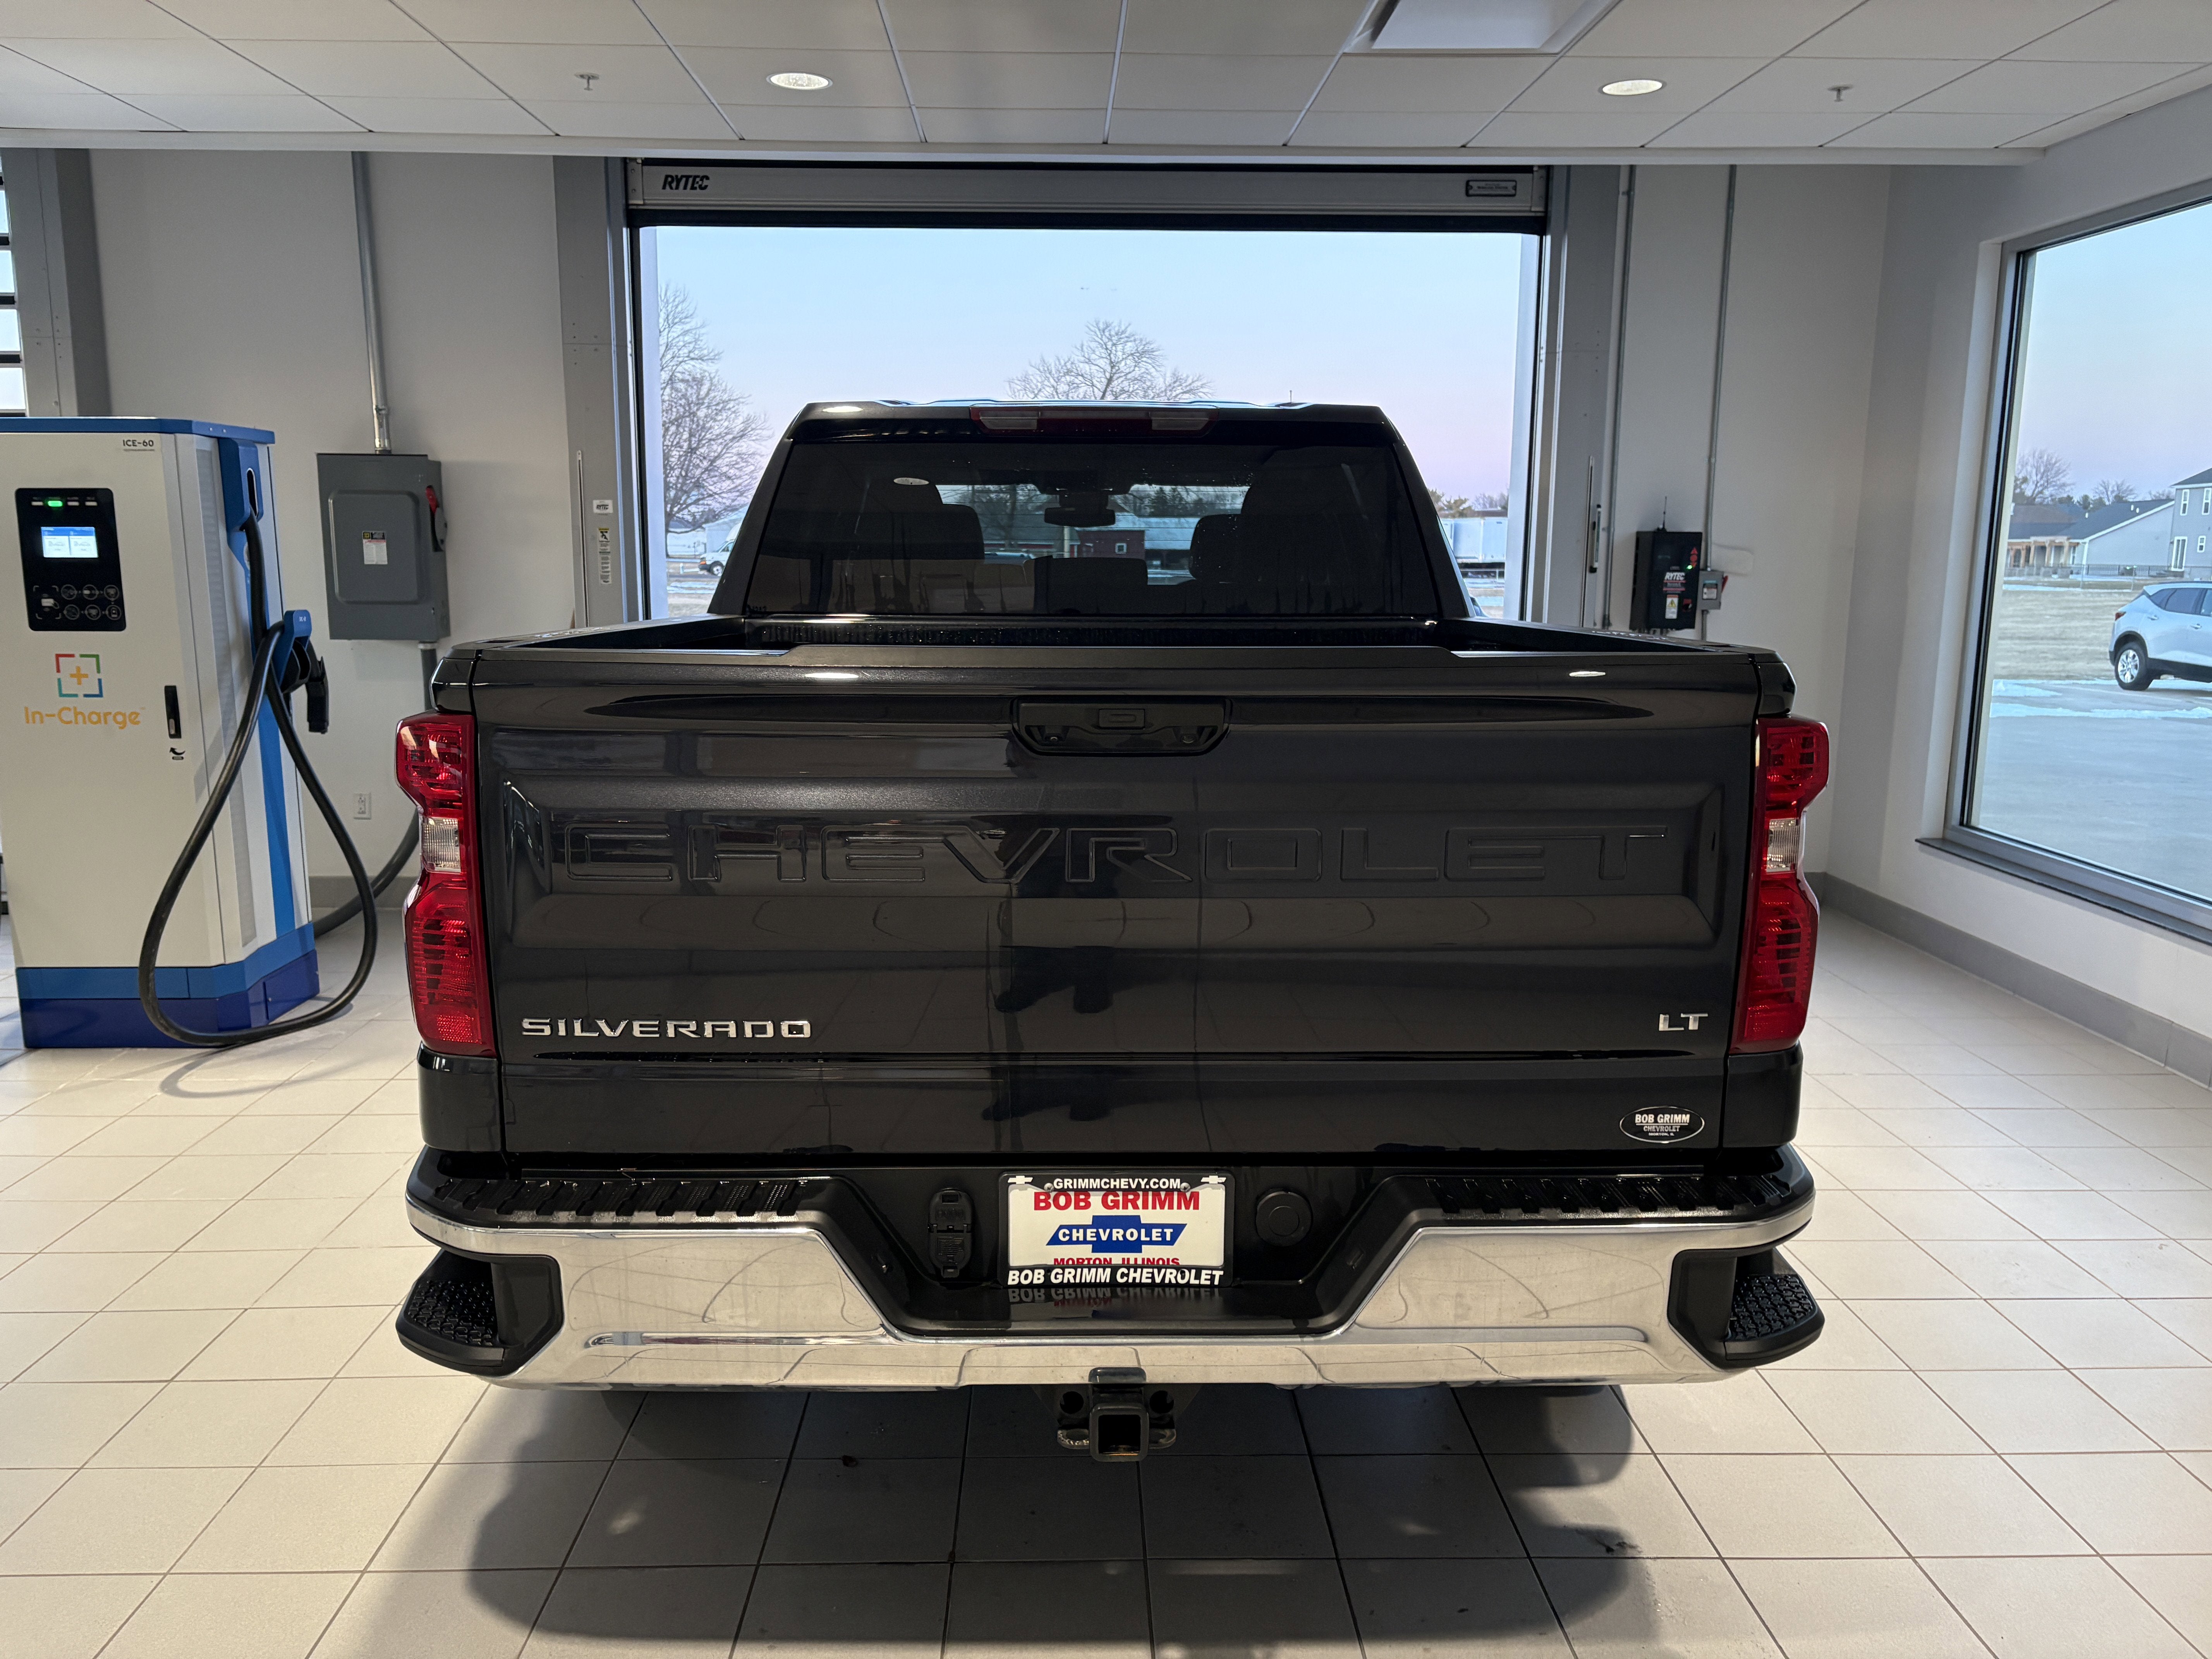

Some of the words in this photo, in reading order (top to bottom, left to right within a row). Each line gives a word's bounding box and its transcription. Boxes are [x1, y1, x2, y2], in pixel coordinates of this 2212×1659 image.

[662, 175, 709, 190] RYTEC
[1664, 572, 1686, 580] RYTEC
[566, 824, 1668, 883] CHEVROLET
[521, 1017, 812, 1038] SILVERADO
[1659, 1013, 1708, 1031] LT
[1635, 1114, 1654, 1123] BOB
[1657, 1114, 1690, 1123] GRIMM
[1053, 1178, 1181, 1189] GRIMMCHEVY.COM
[1034, 1191, 1091, 1210] BOB
[1101, 1191, 1199, 1210] GRIMM
[1058, 1228, 1173, 1242] CHEVROLET
[1008, 1270, 1044, 1285] BOB
[1050, 1268, 1111, 1283] GRIMM
[1116, 1268, 1223, 1285] CHEVROLET
